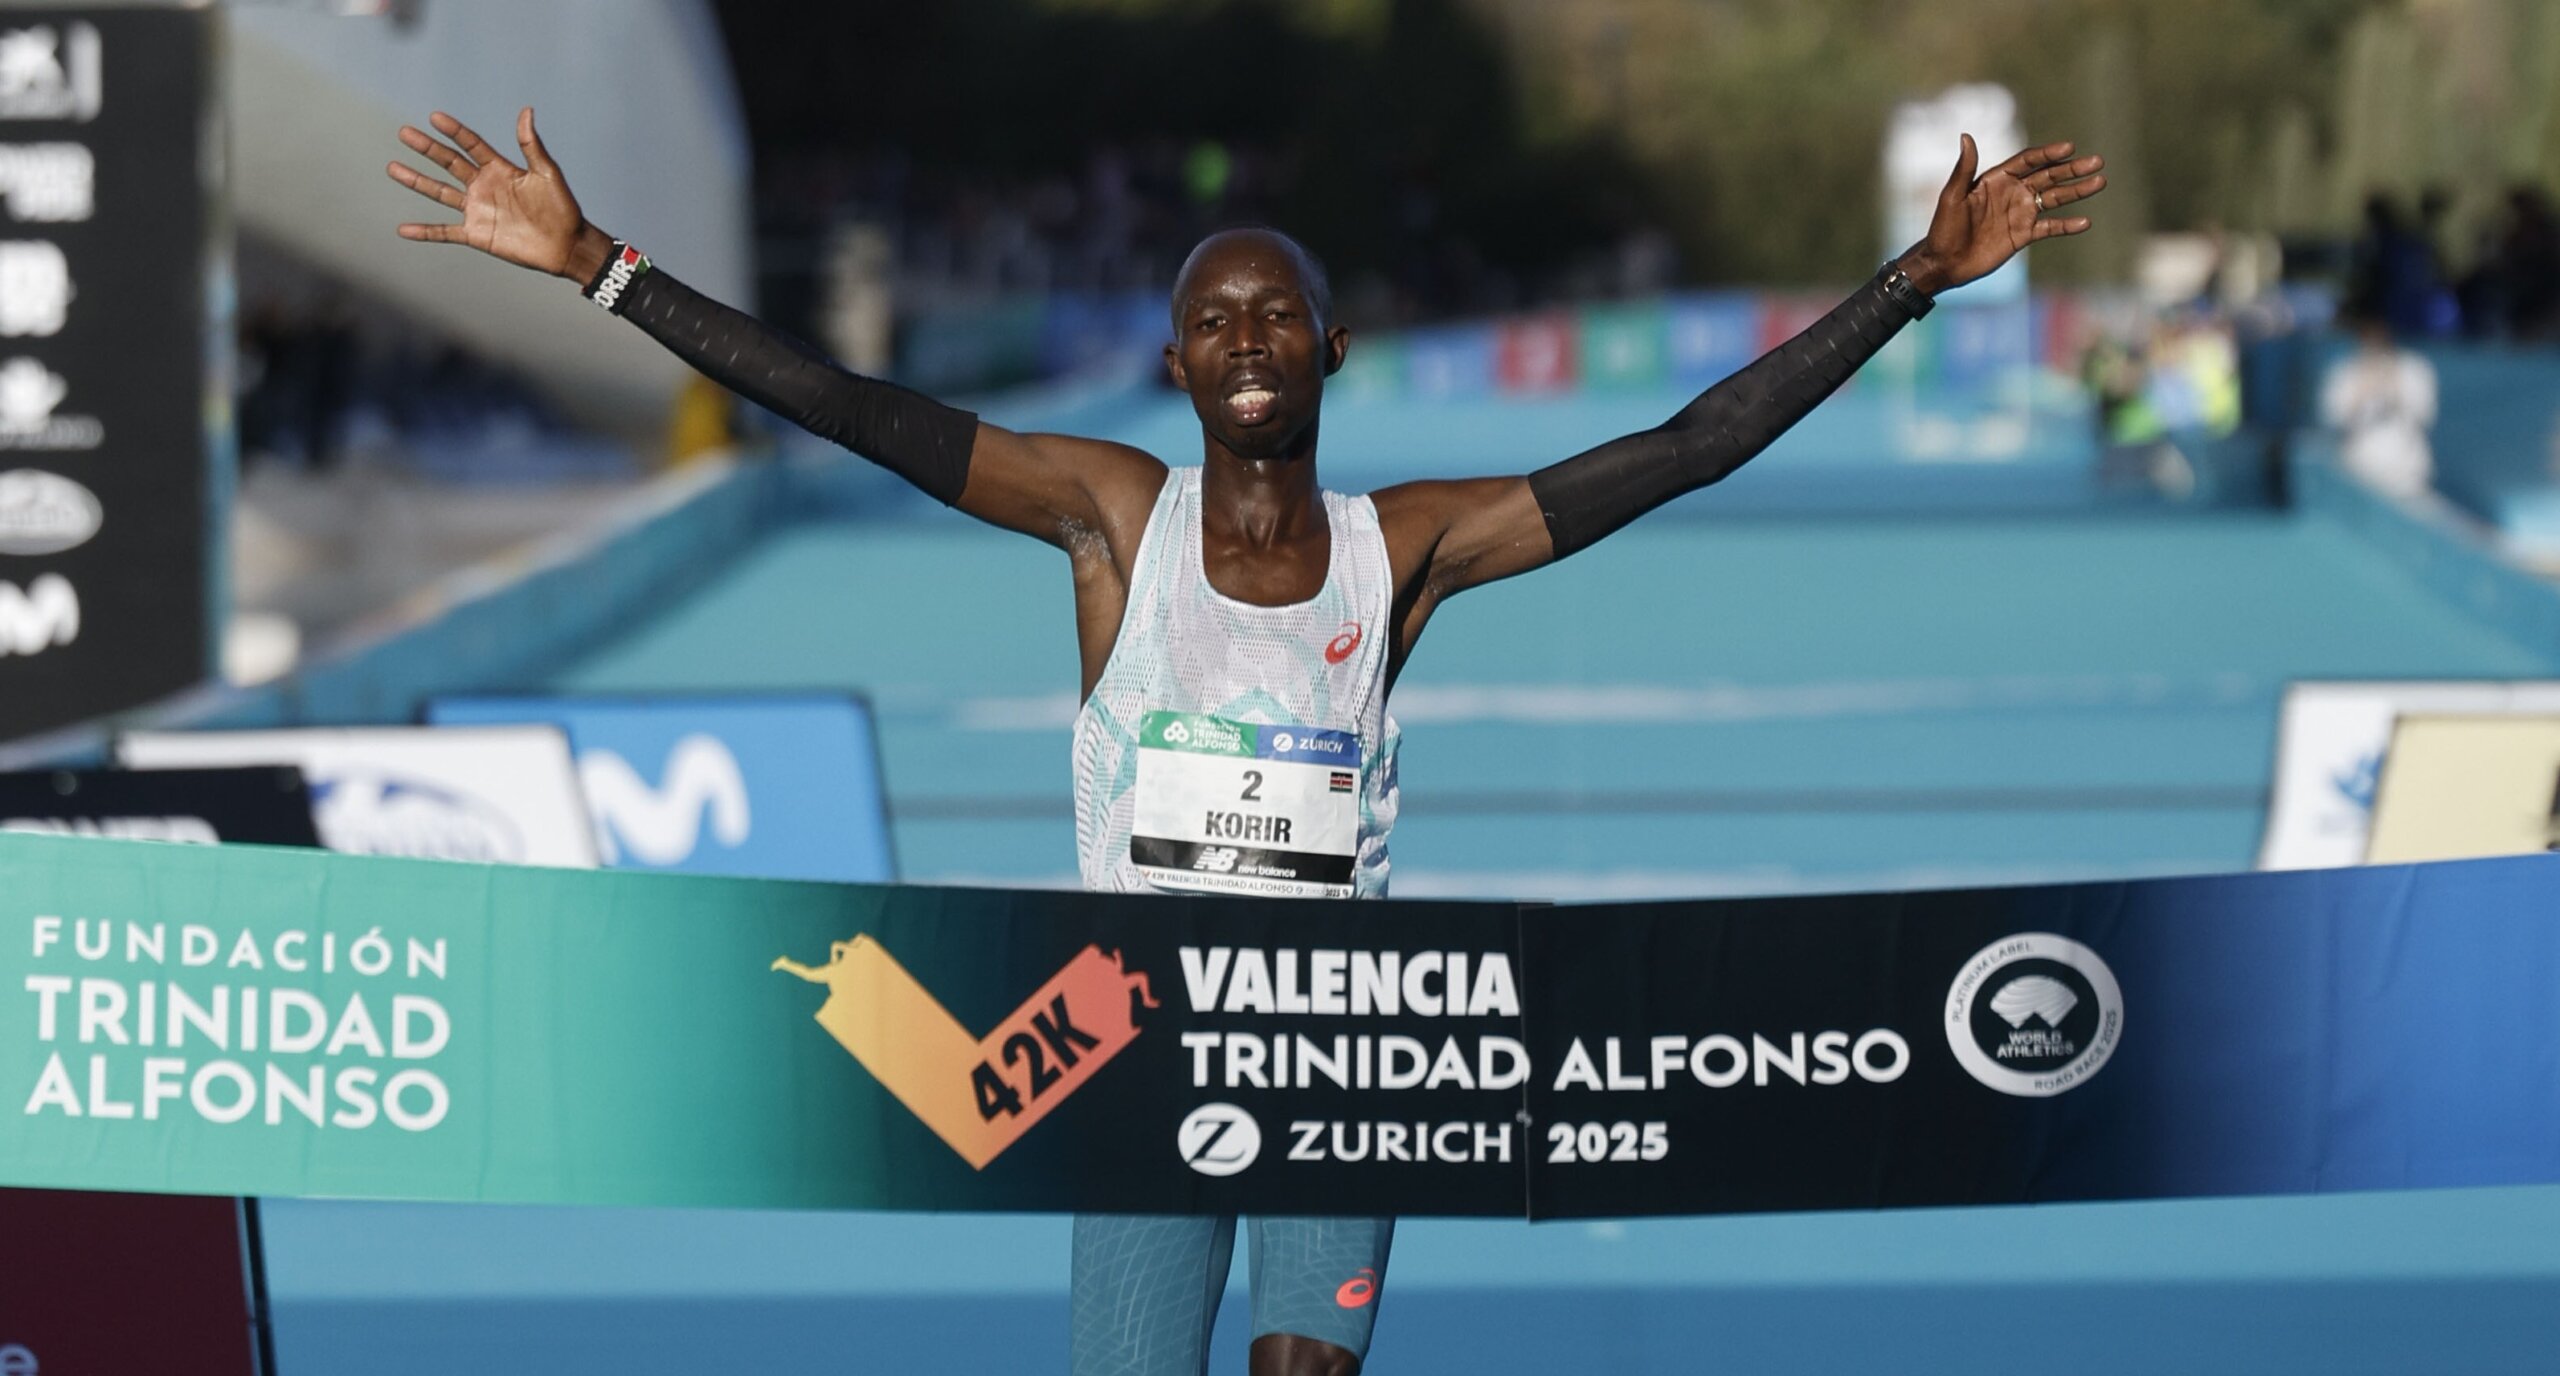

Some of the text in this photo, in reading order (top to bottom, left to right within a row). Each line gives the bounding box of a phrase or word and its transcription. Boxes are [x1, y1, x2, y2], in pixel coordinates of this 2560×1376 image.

[592, 258, 636, 310] ORIR
[1192, 729, 1241, 742] TRINIDAD
[1192, 739, 1241, 752] ALFONSO
[1300, 738, 1344, 754] ZURICH
[1240, 770, 1263, 802] 2
[1205, 810, 1292, 844] KORIR
[1203, 877, 1247, 889] TRINIDAD
[1247, 881, 1294, 894] ALFONSO
[1238, 864, 1297, 879] new balance
[33, 916, 447, 980] FUNDACIÓN
[1179, 947, 1520, 1017] VALENCIA
[1952, 941, 2034, 1023] PLATINUM LABEL
[25, 975, 451, 1060] TRINIDAD
[2008, 1030, 2063, 1045] WORLD
[970, 993, 1101, 1124] 42K
[1181, 1028, 1911, 1092] TRINIDAD ALFONSO
[1997, 1041, 2075, 1059] ATHLETICS
[2034, 1008, 2118, 1091] ROAD RACE 2025
[24, 1050, 450, 1132] ALFONSO
[1288, 1121, 1512, 1163] ZURICH
[1547, 1121, 1669, 1164] 2025
